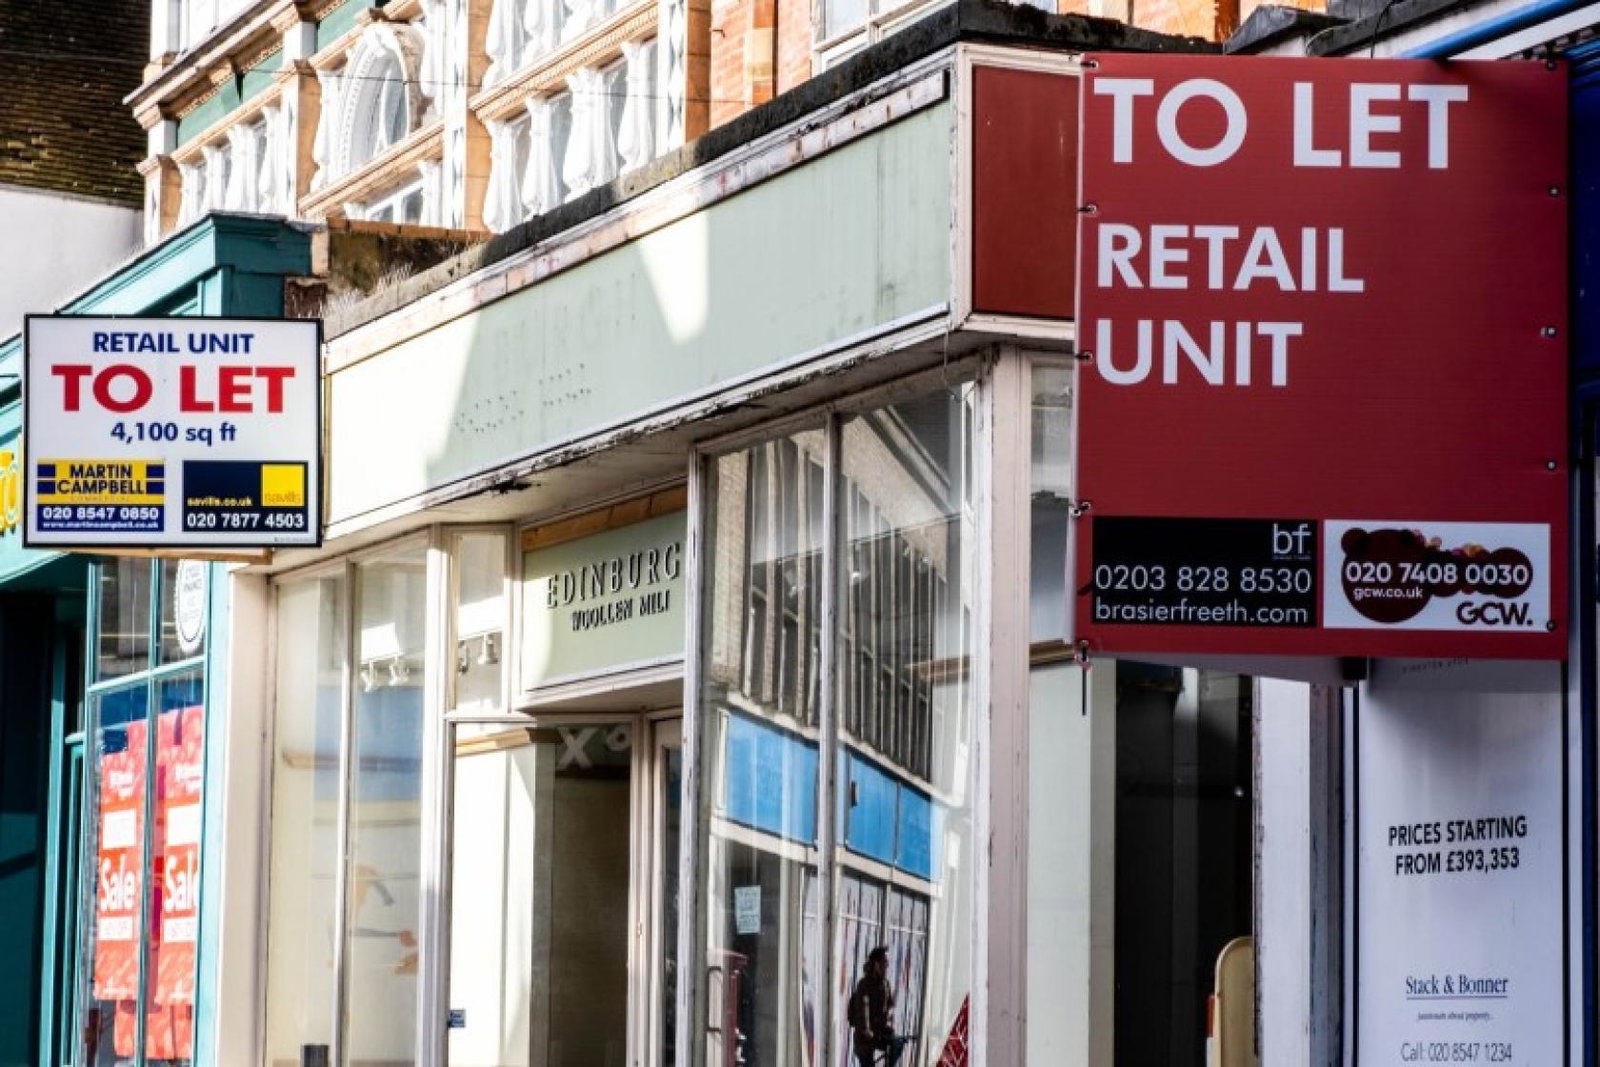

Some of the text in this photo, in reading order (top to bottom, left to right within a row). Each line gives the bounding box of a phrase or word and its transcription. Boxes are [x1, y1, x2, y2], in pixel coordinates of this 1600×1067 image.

[1094, 78, 1468, 169] TO LET
[1098, 223, 1364, 293] RETAIL
[93, 332, 254, 354] RETAIL UNIT
[1096, 319, 1303, 386] UNIT
[51, 364, 296, 413] TO LET
[110, 422, 236, 447] 4,100 sq ft
[70, 464, 132, 478] MARTIN
[57, 480, 144, 494] CAMPBELL
[43, 507, 72, 519] 020
[77, 507, 115, 519] 8547
[187, 513, 304, 528] 020 7877 4503
[1095, 565, 1311, 593] 0203 828 8530
[1346, 561, 1529, 586] 020 7408 0030
[1353, 586, 1423, 601] gcw.co.uk
[1095, 596, 1309, 623] brasierfreeth.com
[1388, 815, 1527, 847] PRICES STARTING
[1396, 847, 1520, 876] FROM £393,353
[100, 853, 135, 911] Sale
[1405, 974, 1508, 994] Stack & Bonner
